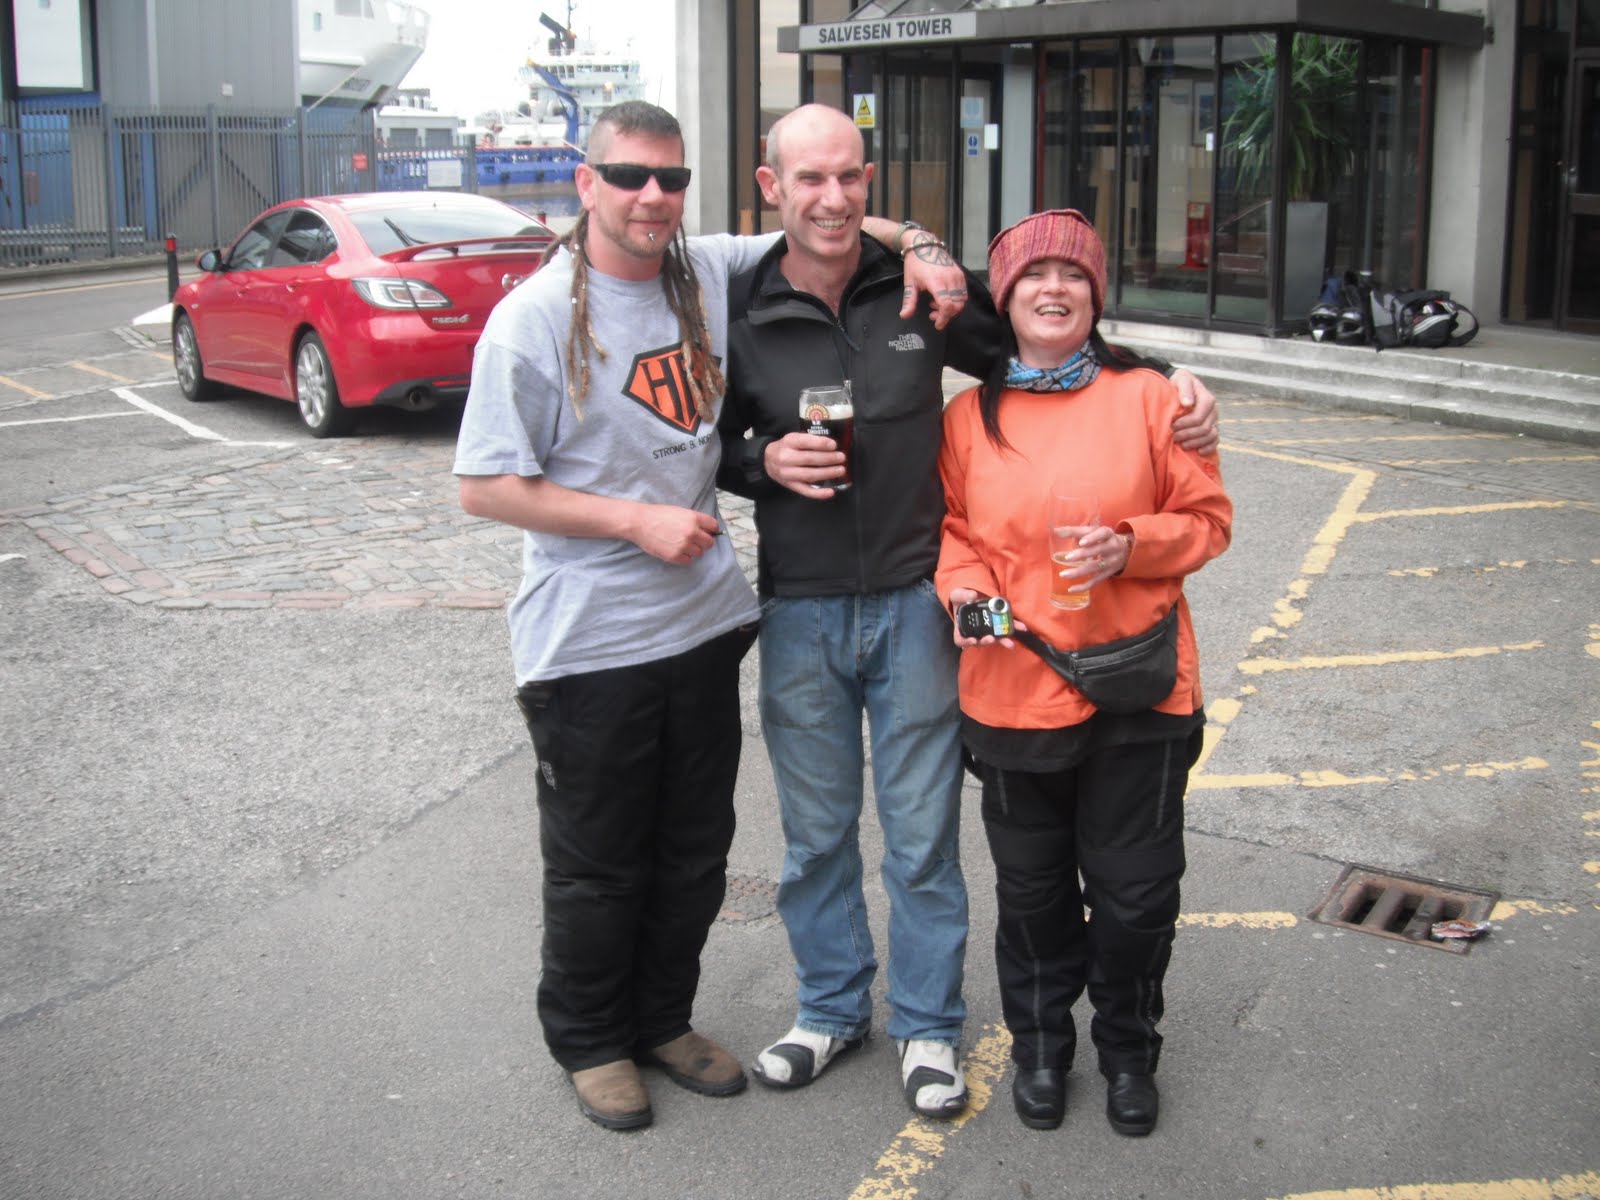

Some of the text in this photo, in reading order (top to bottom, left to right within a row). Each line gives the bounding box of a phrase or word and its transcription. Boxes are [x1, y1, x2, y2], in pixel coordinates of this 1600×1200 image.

[818, 18, 952, 43] SALVESEN TOWER
[888, 339, 912, 348] NORTH
[652, 443, 687, 460] STRONG
[690, 439, 696, 450] &
